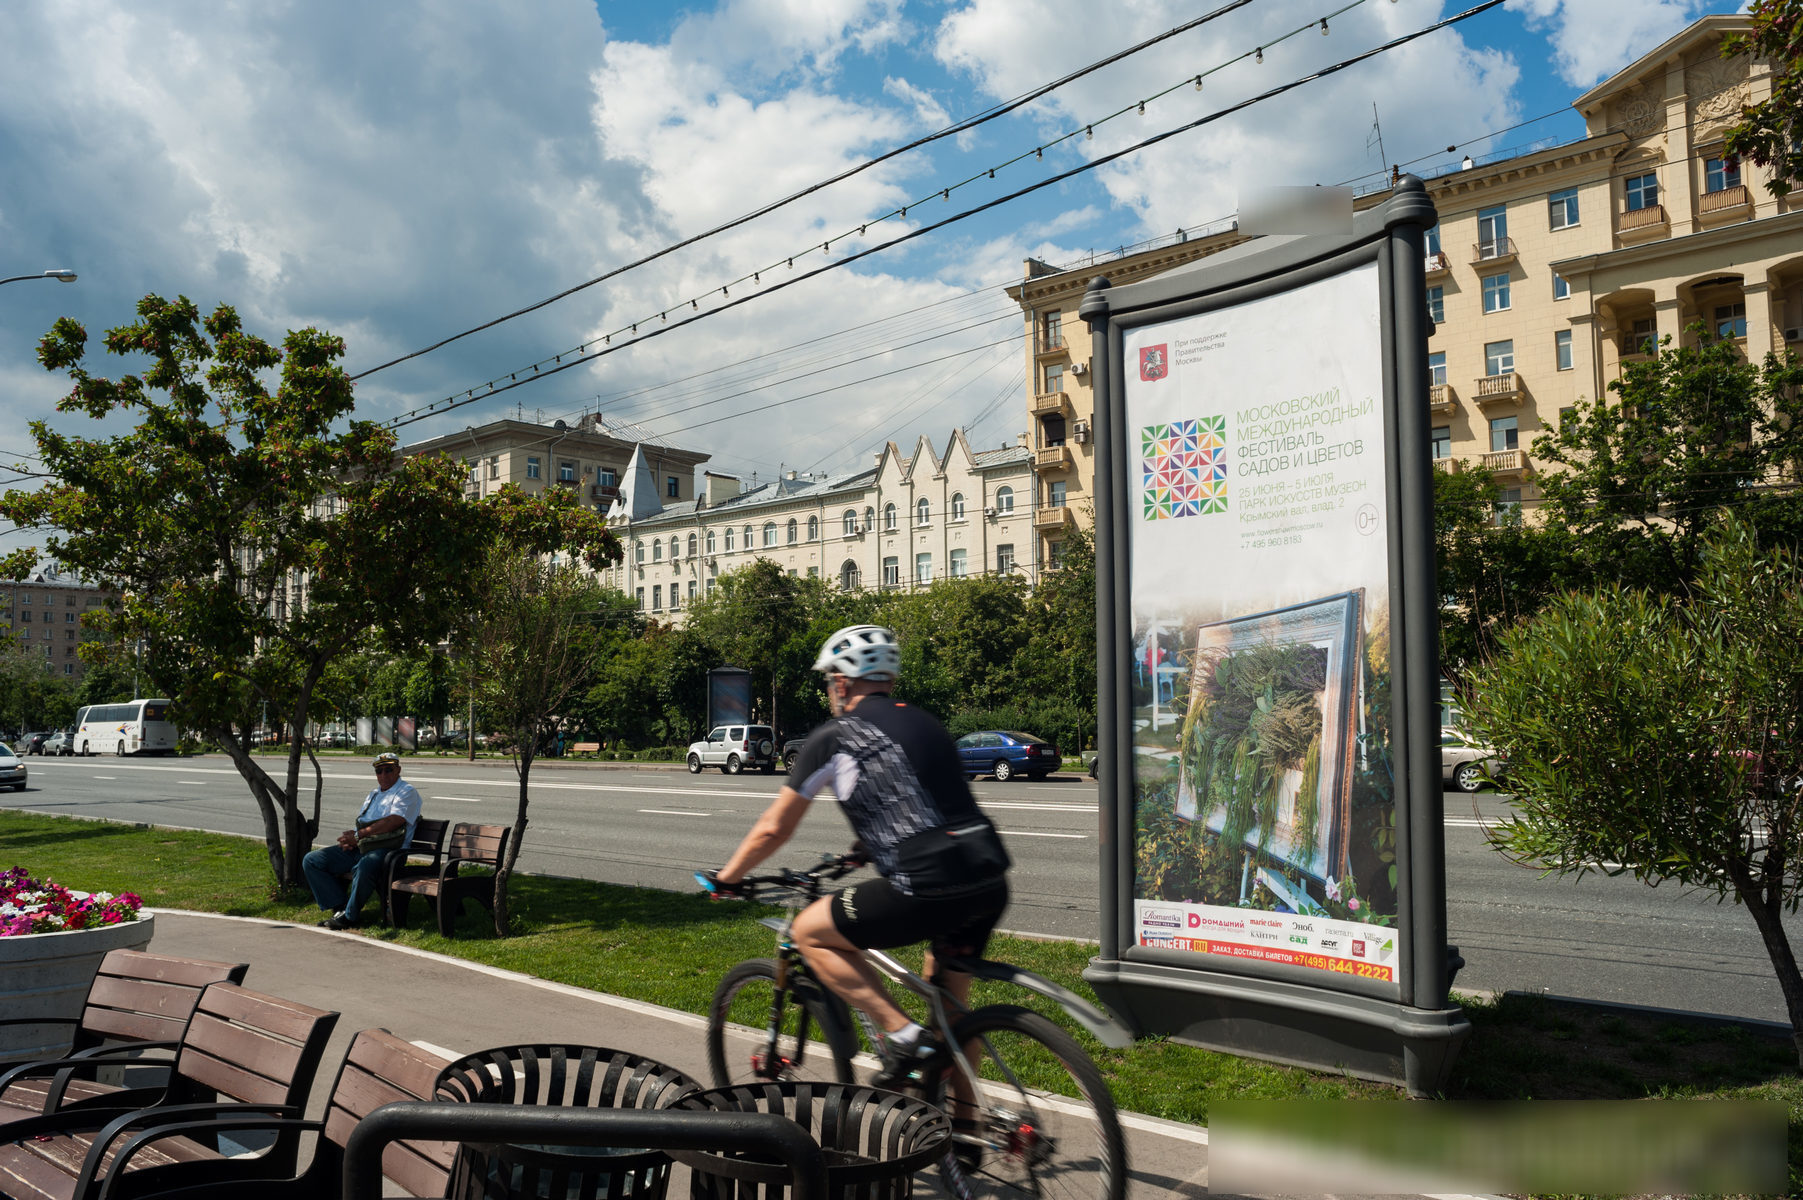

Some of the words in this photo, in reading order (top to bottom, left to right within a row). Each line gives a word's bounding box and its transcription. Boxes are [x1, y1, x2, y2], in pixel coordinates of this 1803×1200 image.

[1175, 340, 1189, 348] При
[1189, 331, 1228, 345] поддержке
[1175, 341, 1225, 358] Правительства
[1175, 356, 1203, 366] Москвы
[1236, 385, 1341, 424] МОСКОВСКИЙ
[1236, 395, 1374, 442] МЕЖДУНАРОДНЫЙ
[1237, 431, 1325, 459] ФЕСТИВАЛЬ
[1238, 455, 1290, 477] САДОВ
[1293, 452, 1304, 468] И
[1307, 439, 1364, 466] ЦВЕТОВ
[1239, 487, 1251, 498] 25
[1253, 481, 1285, 496] ИЮНЯ
[1295, 479, 1301, 489] 5
[1303, 472, 1334, 488] ИЮЛЯ
[1239, 498, 1267, 511] ПАРК
[1269, 488, 1323, 506] ИСКУССТВ
[1324, 479, 1367, 497] МУЗЕОН
[1239, 510, 1288, 524] Крымский
[1338, 497, 1345, 508] 2
[1359, 511, 1377, 529] 0+
[1241, 541, 1250, 549] +7
[1252, 538, 1266, 549] 495
[1267, 536, 1282, 547] 960
[1143, 910, 1181, 921] Romantika
[1268, 919, 1283, 928] claire
[1289, 935, 1308, 944] сад
[1233, 947, 1264, 958] ДОСТАВКА
[1265, 952, 1292, 962] БИЛЕТОВ
[1294, 954, 1327, 968] +7(495)
[1328, 958, 1354, 974] 644
[1356, 963, 1390, 982] 2222
